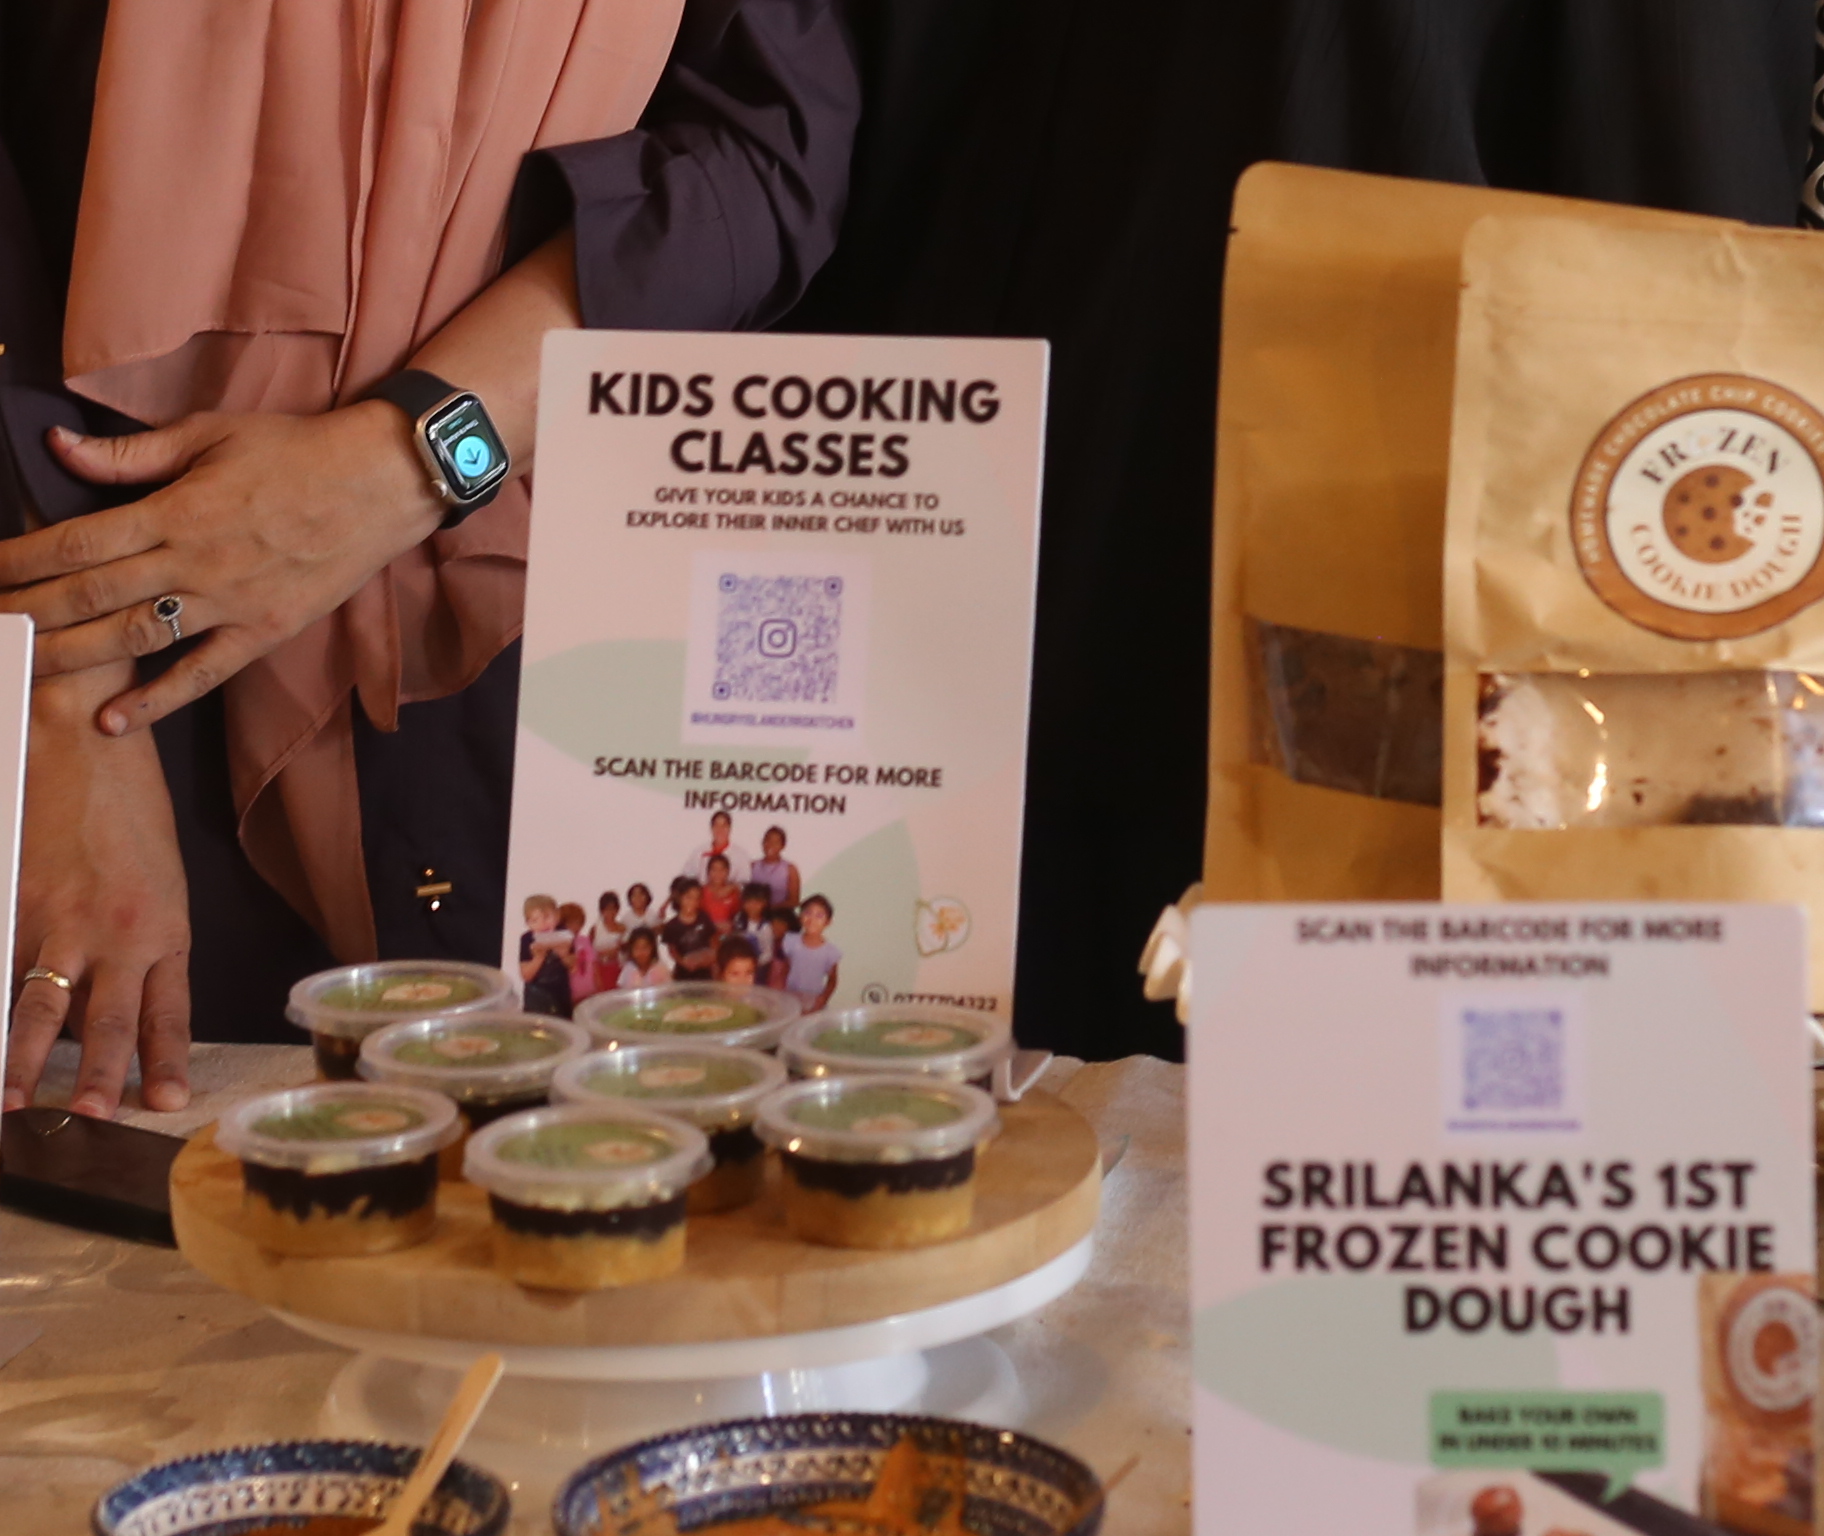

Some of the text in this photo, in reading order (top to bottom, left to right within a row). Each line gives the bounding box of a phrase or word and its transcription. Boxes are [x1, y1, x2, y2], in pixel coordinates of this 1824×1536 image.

[589, 371, 1000, 424] KIDS COOKING
[670, 429, 910, 478] CLASSES
[655, 487, 939, 511] GIVE YOUR KIDS A CHANCE TO
[626, 510, 965, 537] EXPLORE THEIR INNER CHEF WITH US
[593, 756, 942, 789] SCAN THE BARCODE FOR MORE
[684, 789, 846, 816] INFORMATION
[1296, 918, 1724, 944] SCAN THE BARCODE FOR MORE
[1410, 954, 1610, 979] INFORMATION
[1261, 1160, 1757, 1211] SRILANKA'S 1ST
[1259, 1223, 1777, 1274] FROZEN COOKIE
[1403, 1285, 1631, 1335] DOUGH
